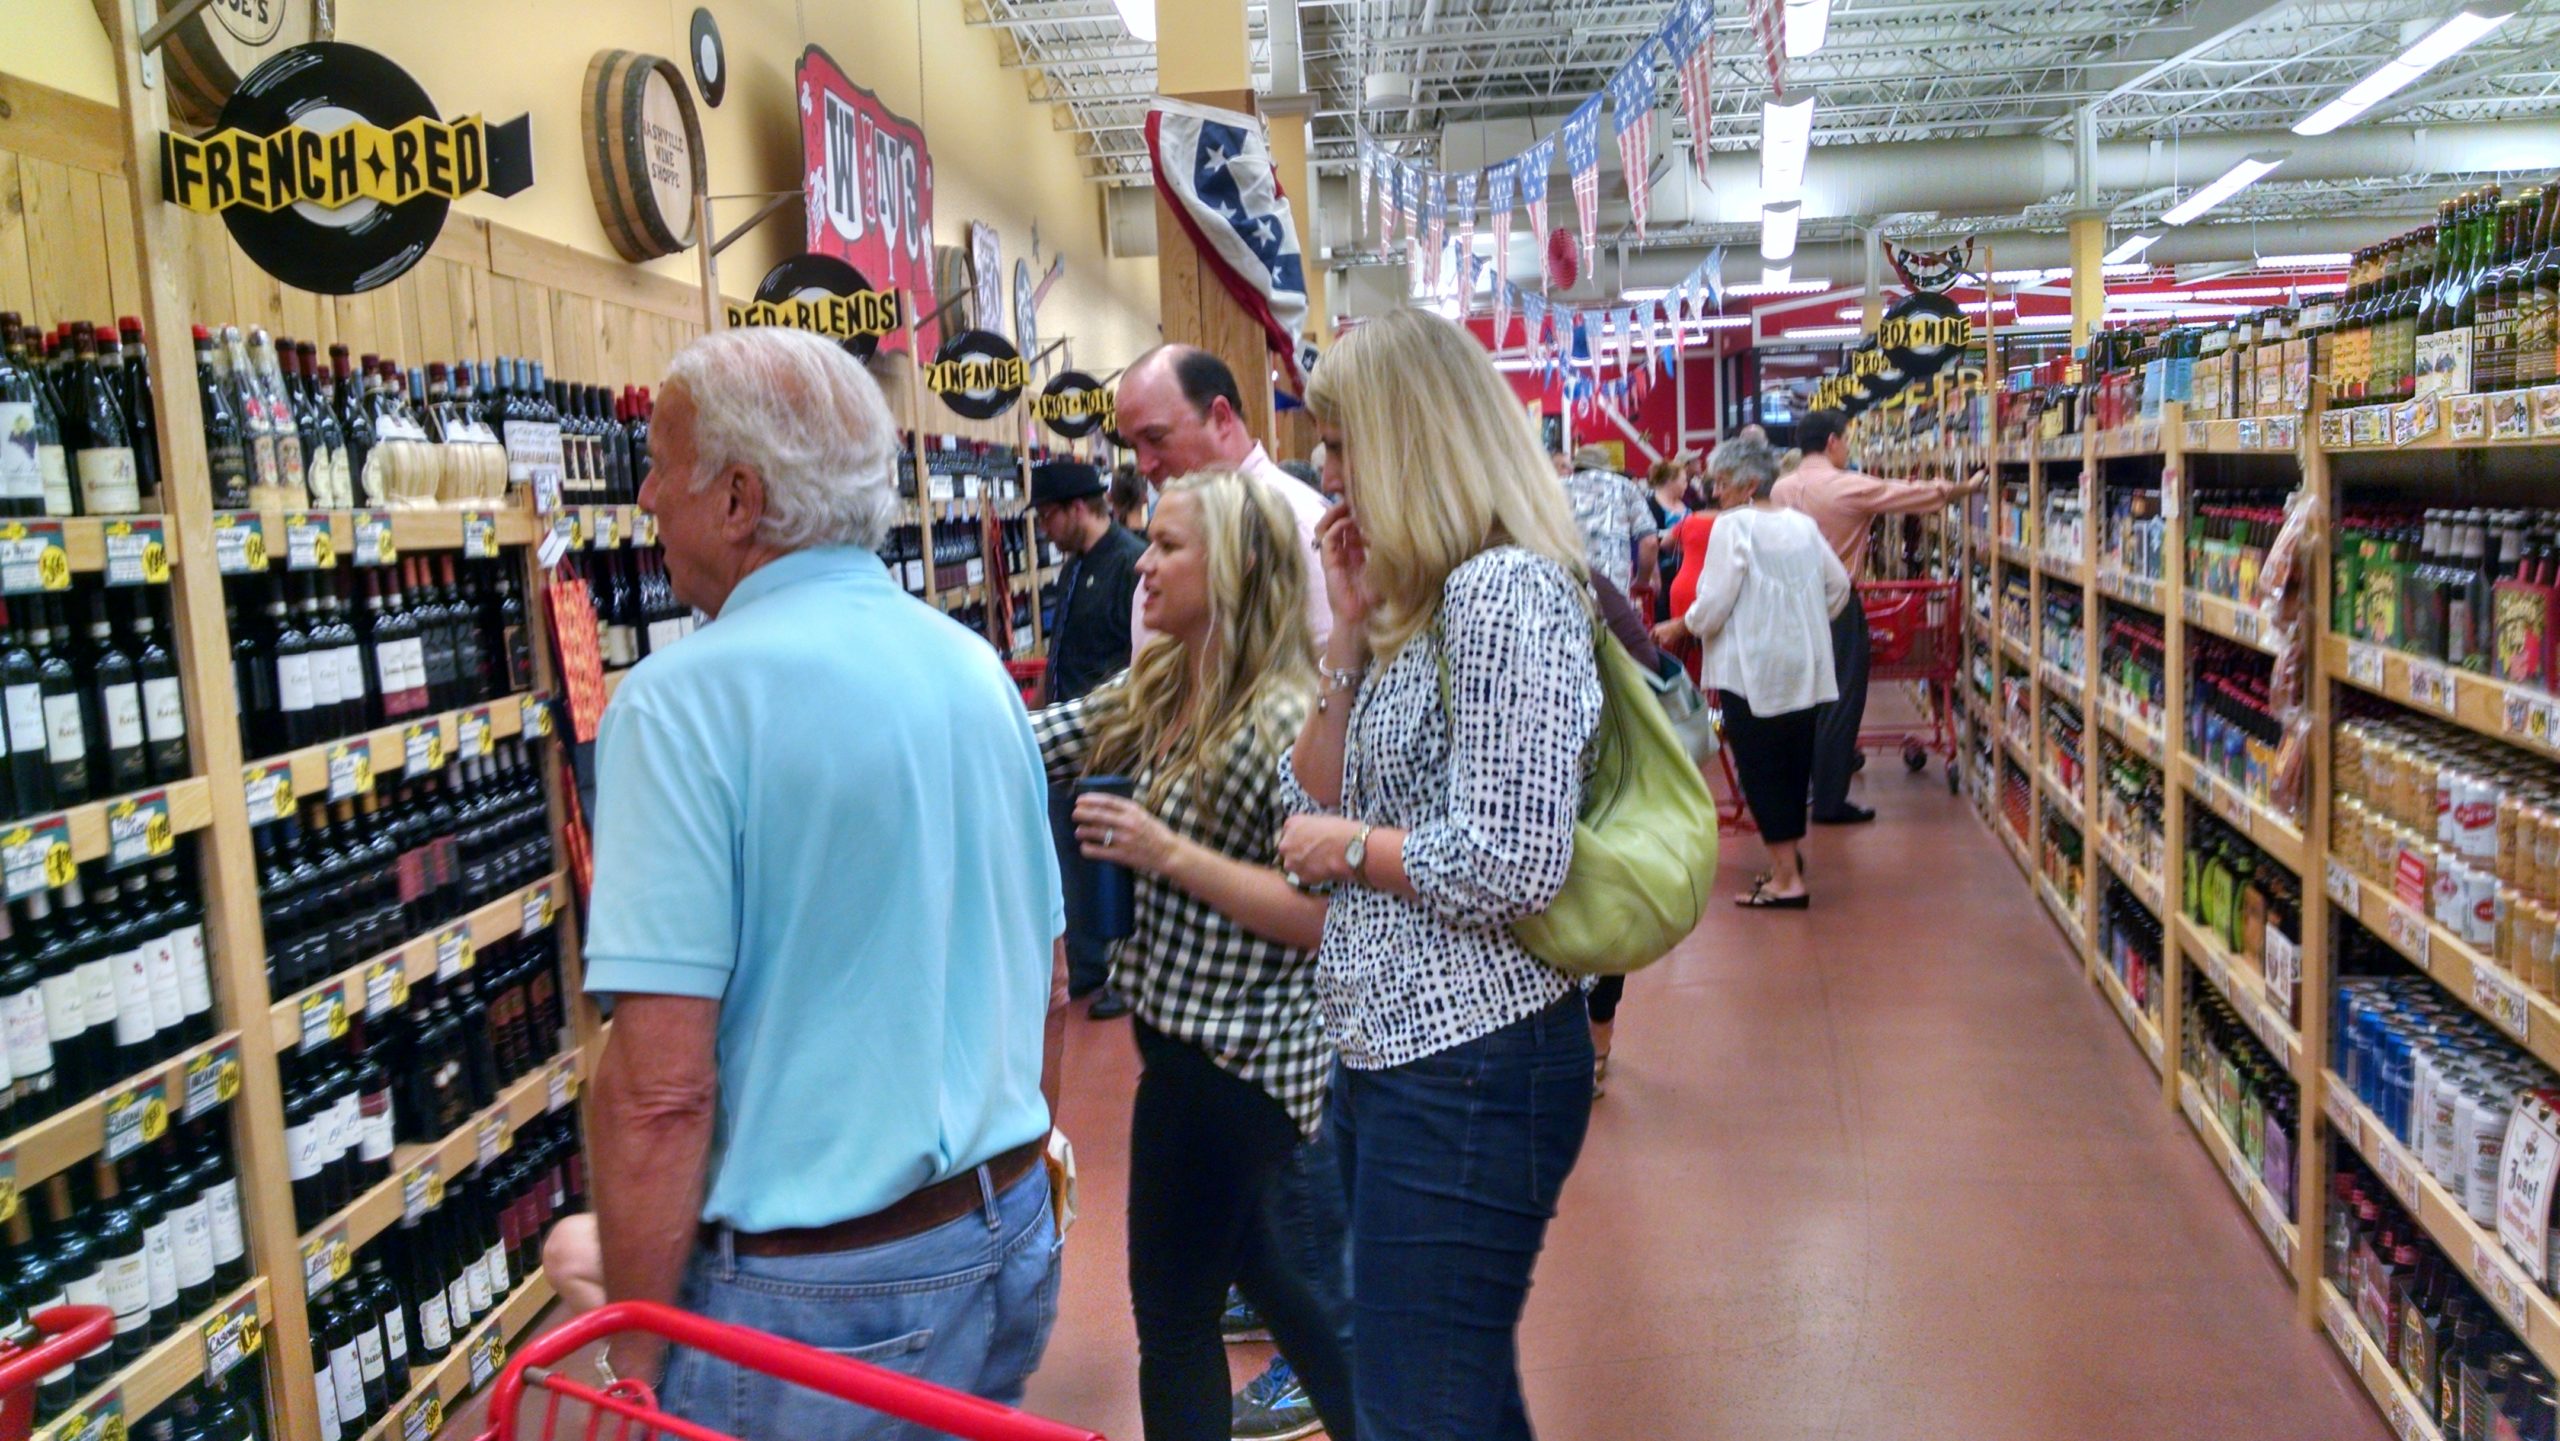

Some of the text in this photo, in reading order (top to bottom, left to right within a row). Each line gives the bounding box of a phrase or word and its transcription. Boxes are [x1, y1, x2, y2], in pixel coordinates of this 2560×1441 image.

[173, 121, 483, 207] FRENCH RED
[824, 88, 919, 260] WINE
[796, 292, 894, 336] BLENDS
[1879, 317, 1971, 347] BOX WINE
[926, 357, 1027, 392] ZINFANDEL
[1029, 390, 1115, 418] PINOT NOIR
[2507, 1157, 2540, 1209] Josef
